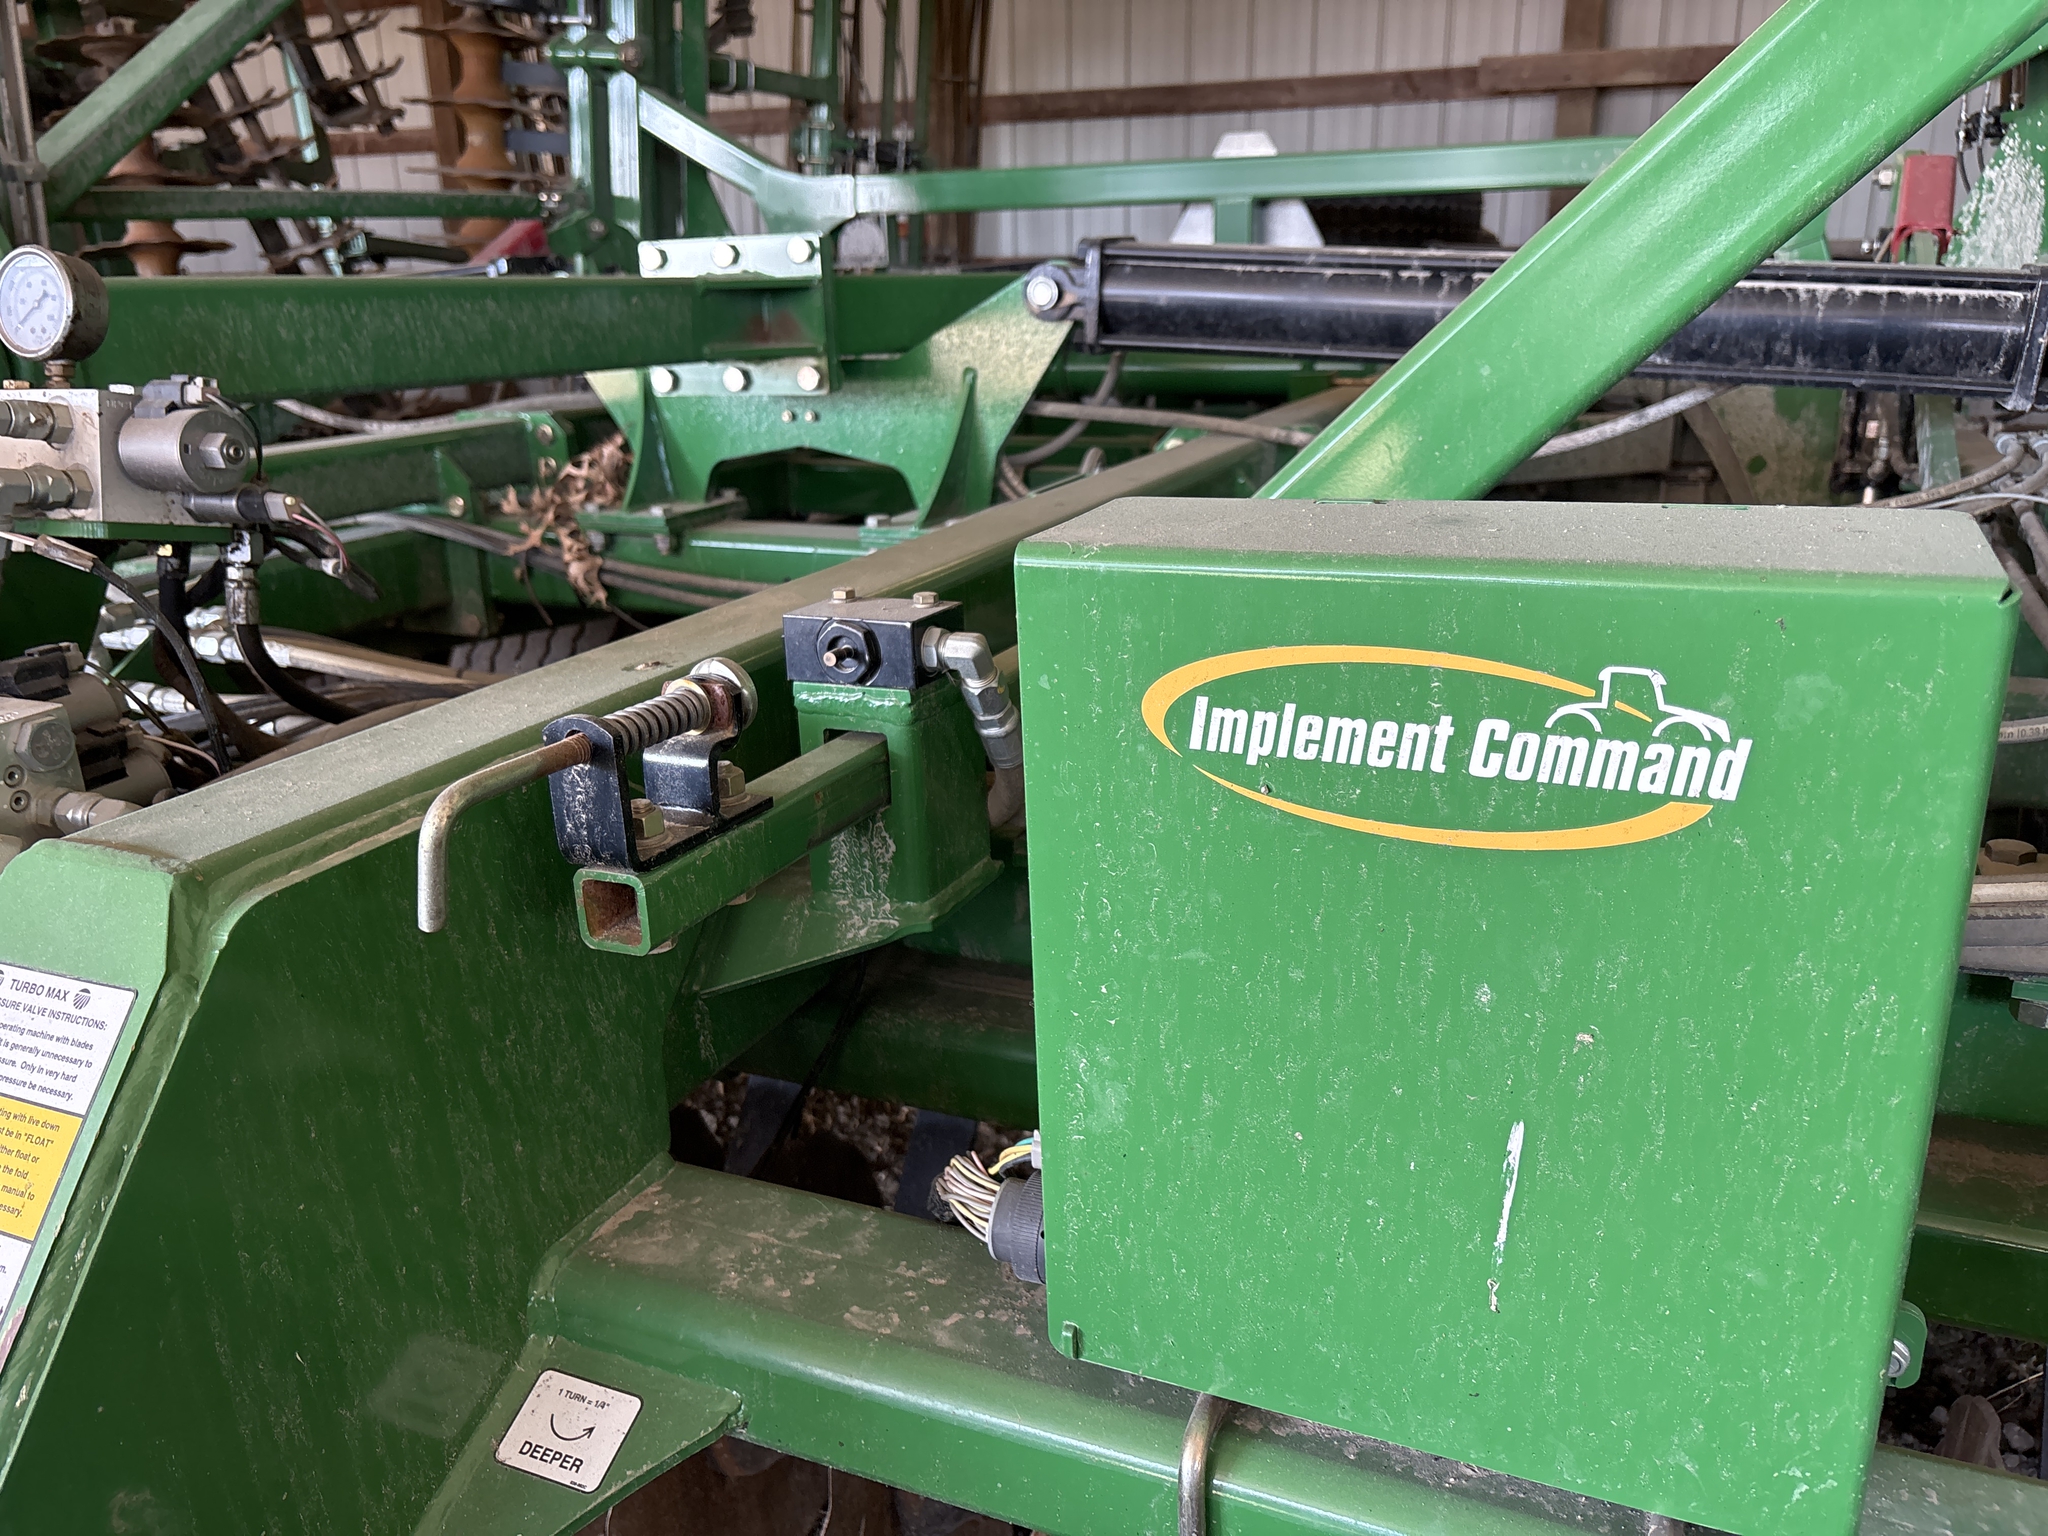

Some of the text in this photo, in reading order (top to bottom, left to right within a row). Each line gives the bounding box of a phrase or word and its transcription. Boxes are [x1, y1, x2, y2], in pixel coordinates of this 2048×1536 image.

[1188, 695, 1754, 802] Implement Command
[10, 978, 70, 1002] TURBO MAX
[22, 1001, 48, 1017] VALVE
[47, 1008, 108, 1031] INSTRUCTIONS:
[26, 1029, 55, 1042] machine
[55, 1035, 70, 1046] with
[70, 1038, 94, 1051] blades
[3, 1038, 10, 1048] is
[9, 1042, 41, 1058] generally
[41, 1050, 85, 1068] unnecessary
[84, 1059, 93, 1069] to
[20, 1060, 37, 1074] Only
[36, 1064, 44, 1075] in
[45, 1068, 60, 1081] very
[60, 1071, 78, 1083] hard
[27, 1080, 37, 1091] be
[37, 1084, 74, 1102] necessary.
[12, 1112, 27, 1123] with
[27, 1115, 40, 1127] live
[40, 1120, 60, 1132] down
[4, 1127, 14, 1138] be
[14, 1130, 22, 1140] in
[24, 1132, 55, 1148] "FLOAT"
[14, 1149, 32, 1162] float
[31, 1156, 40, 1164] or
[2, 1164, 30, 1180] the fold
[1, 1184, 35, 1201] manual to
[558, 1388, 564, 1396] 1
[564, 1390, 588, 1404] TURN
[518, 1440, 584, 1474] DEEPER
